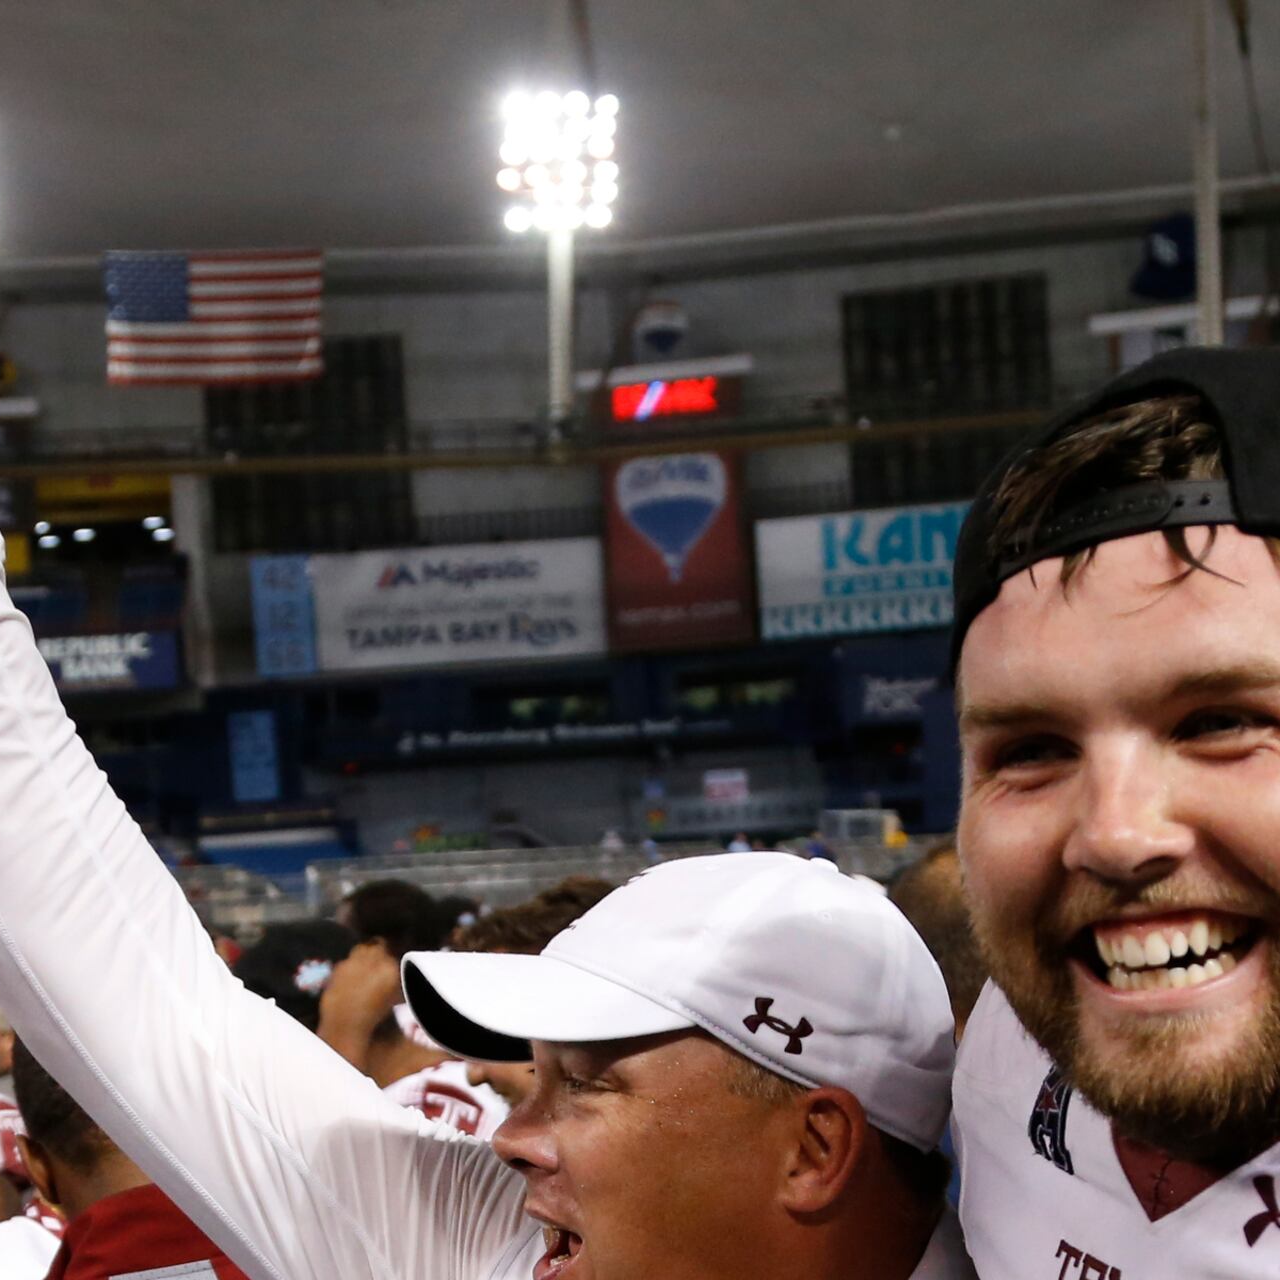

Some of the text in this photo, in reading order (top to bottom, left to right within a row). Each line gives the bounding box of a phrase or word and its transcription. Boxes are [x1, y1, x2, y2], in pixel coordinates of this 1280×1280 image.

[421, 558, 541, 590] Majestic
[36, 632, 153, 662] REPUBLIC
[346, 612, 579, 650] TAMPA BAY Rays
